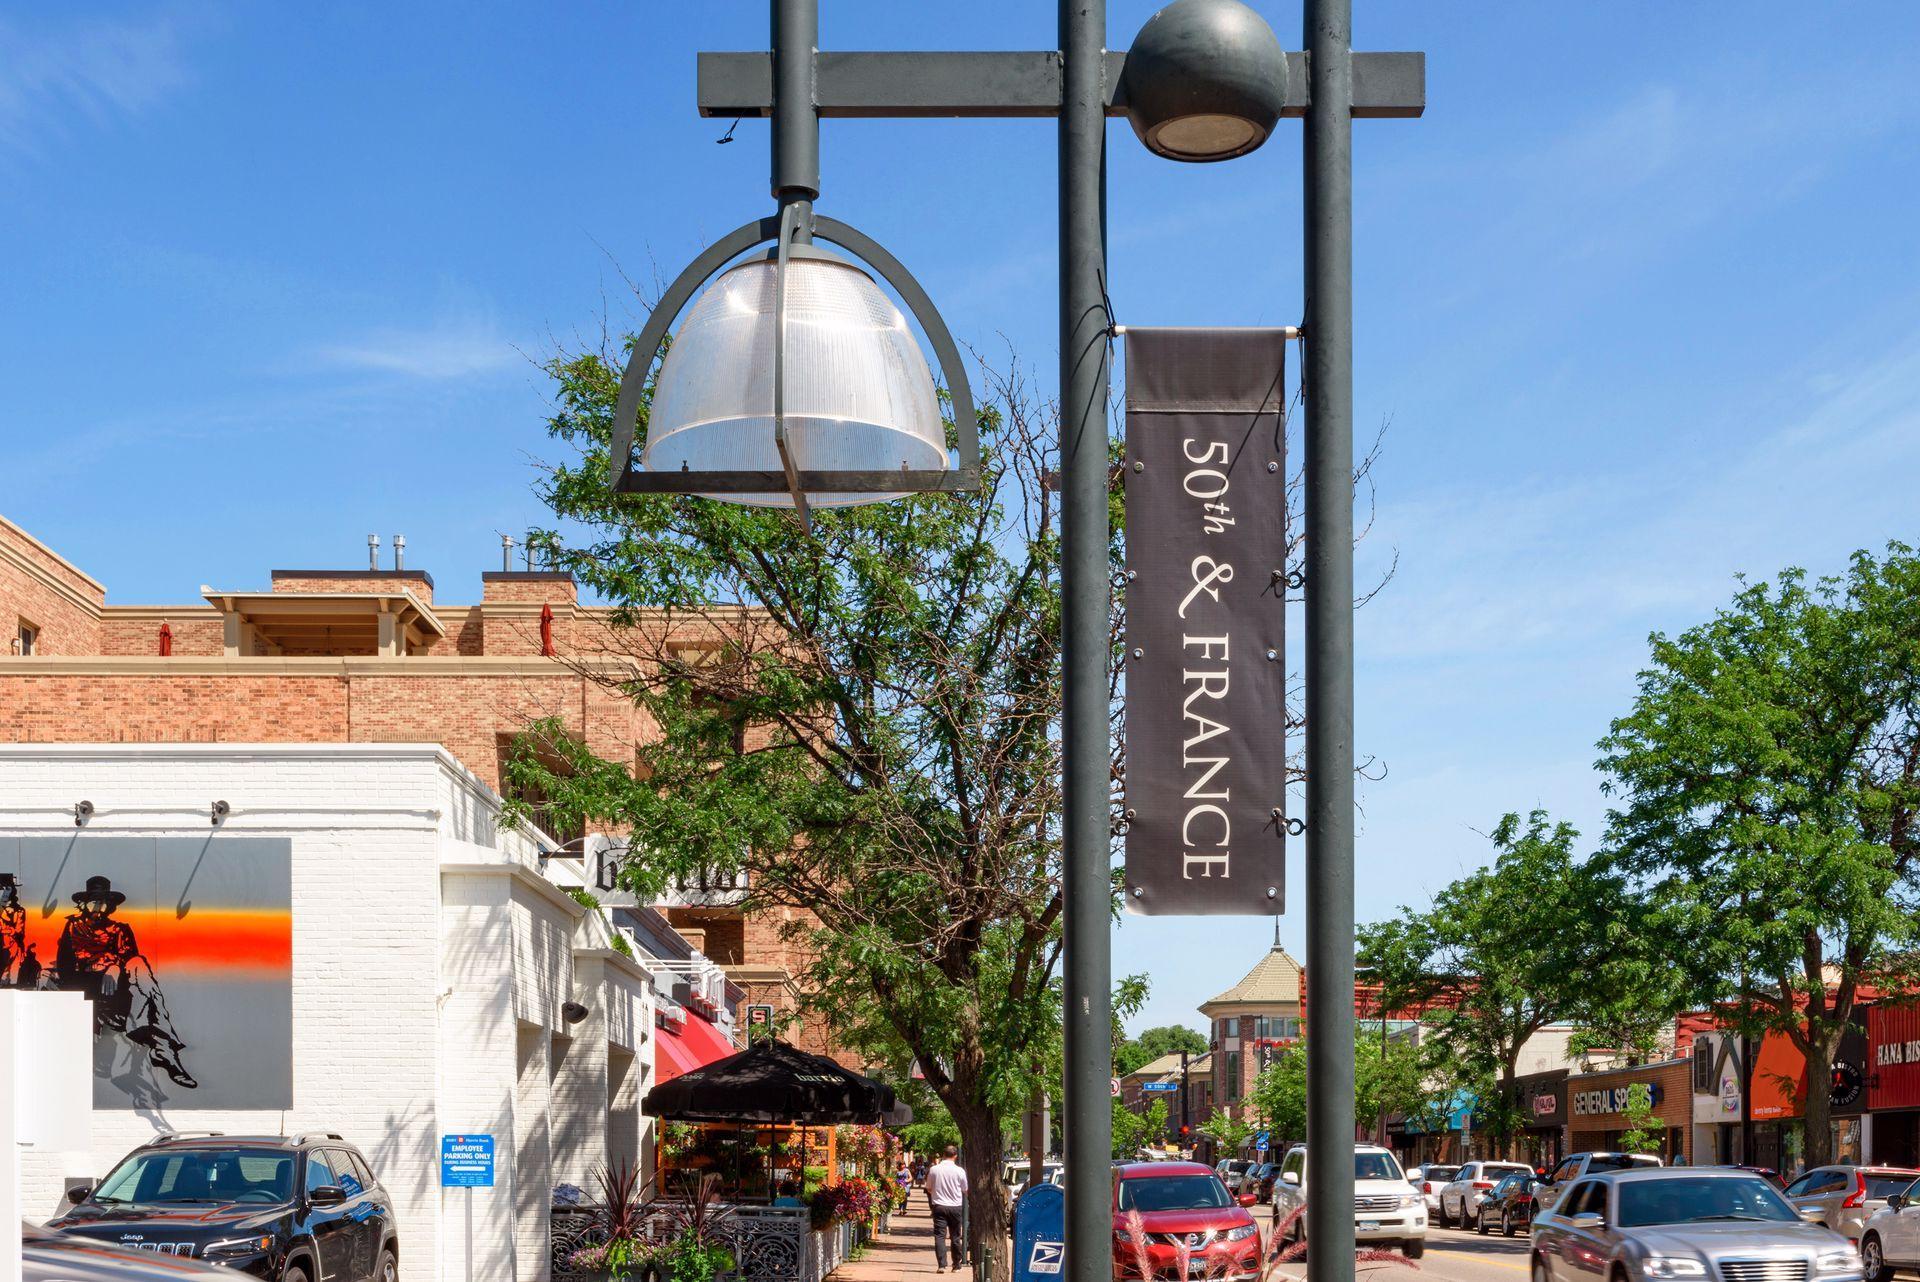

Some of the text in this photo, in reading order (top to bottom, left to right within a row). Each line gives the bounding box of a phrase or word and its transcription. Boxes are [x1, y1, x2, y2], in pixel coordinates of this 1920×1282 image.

[1178, 438, 1236, 880] 50th & FRANCE
[1877, 1043, 1902, 1066] HANA
[794, 1073, 845, 1085] barrio
[1574, 1090, 1613, 1115] GENERAL
